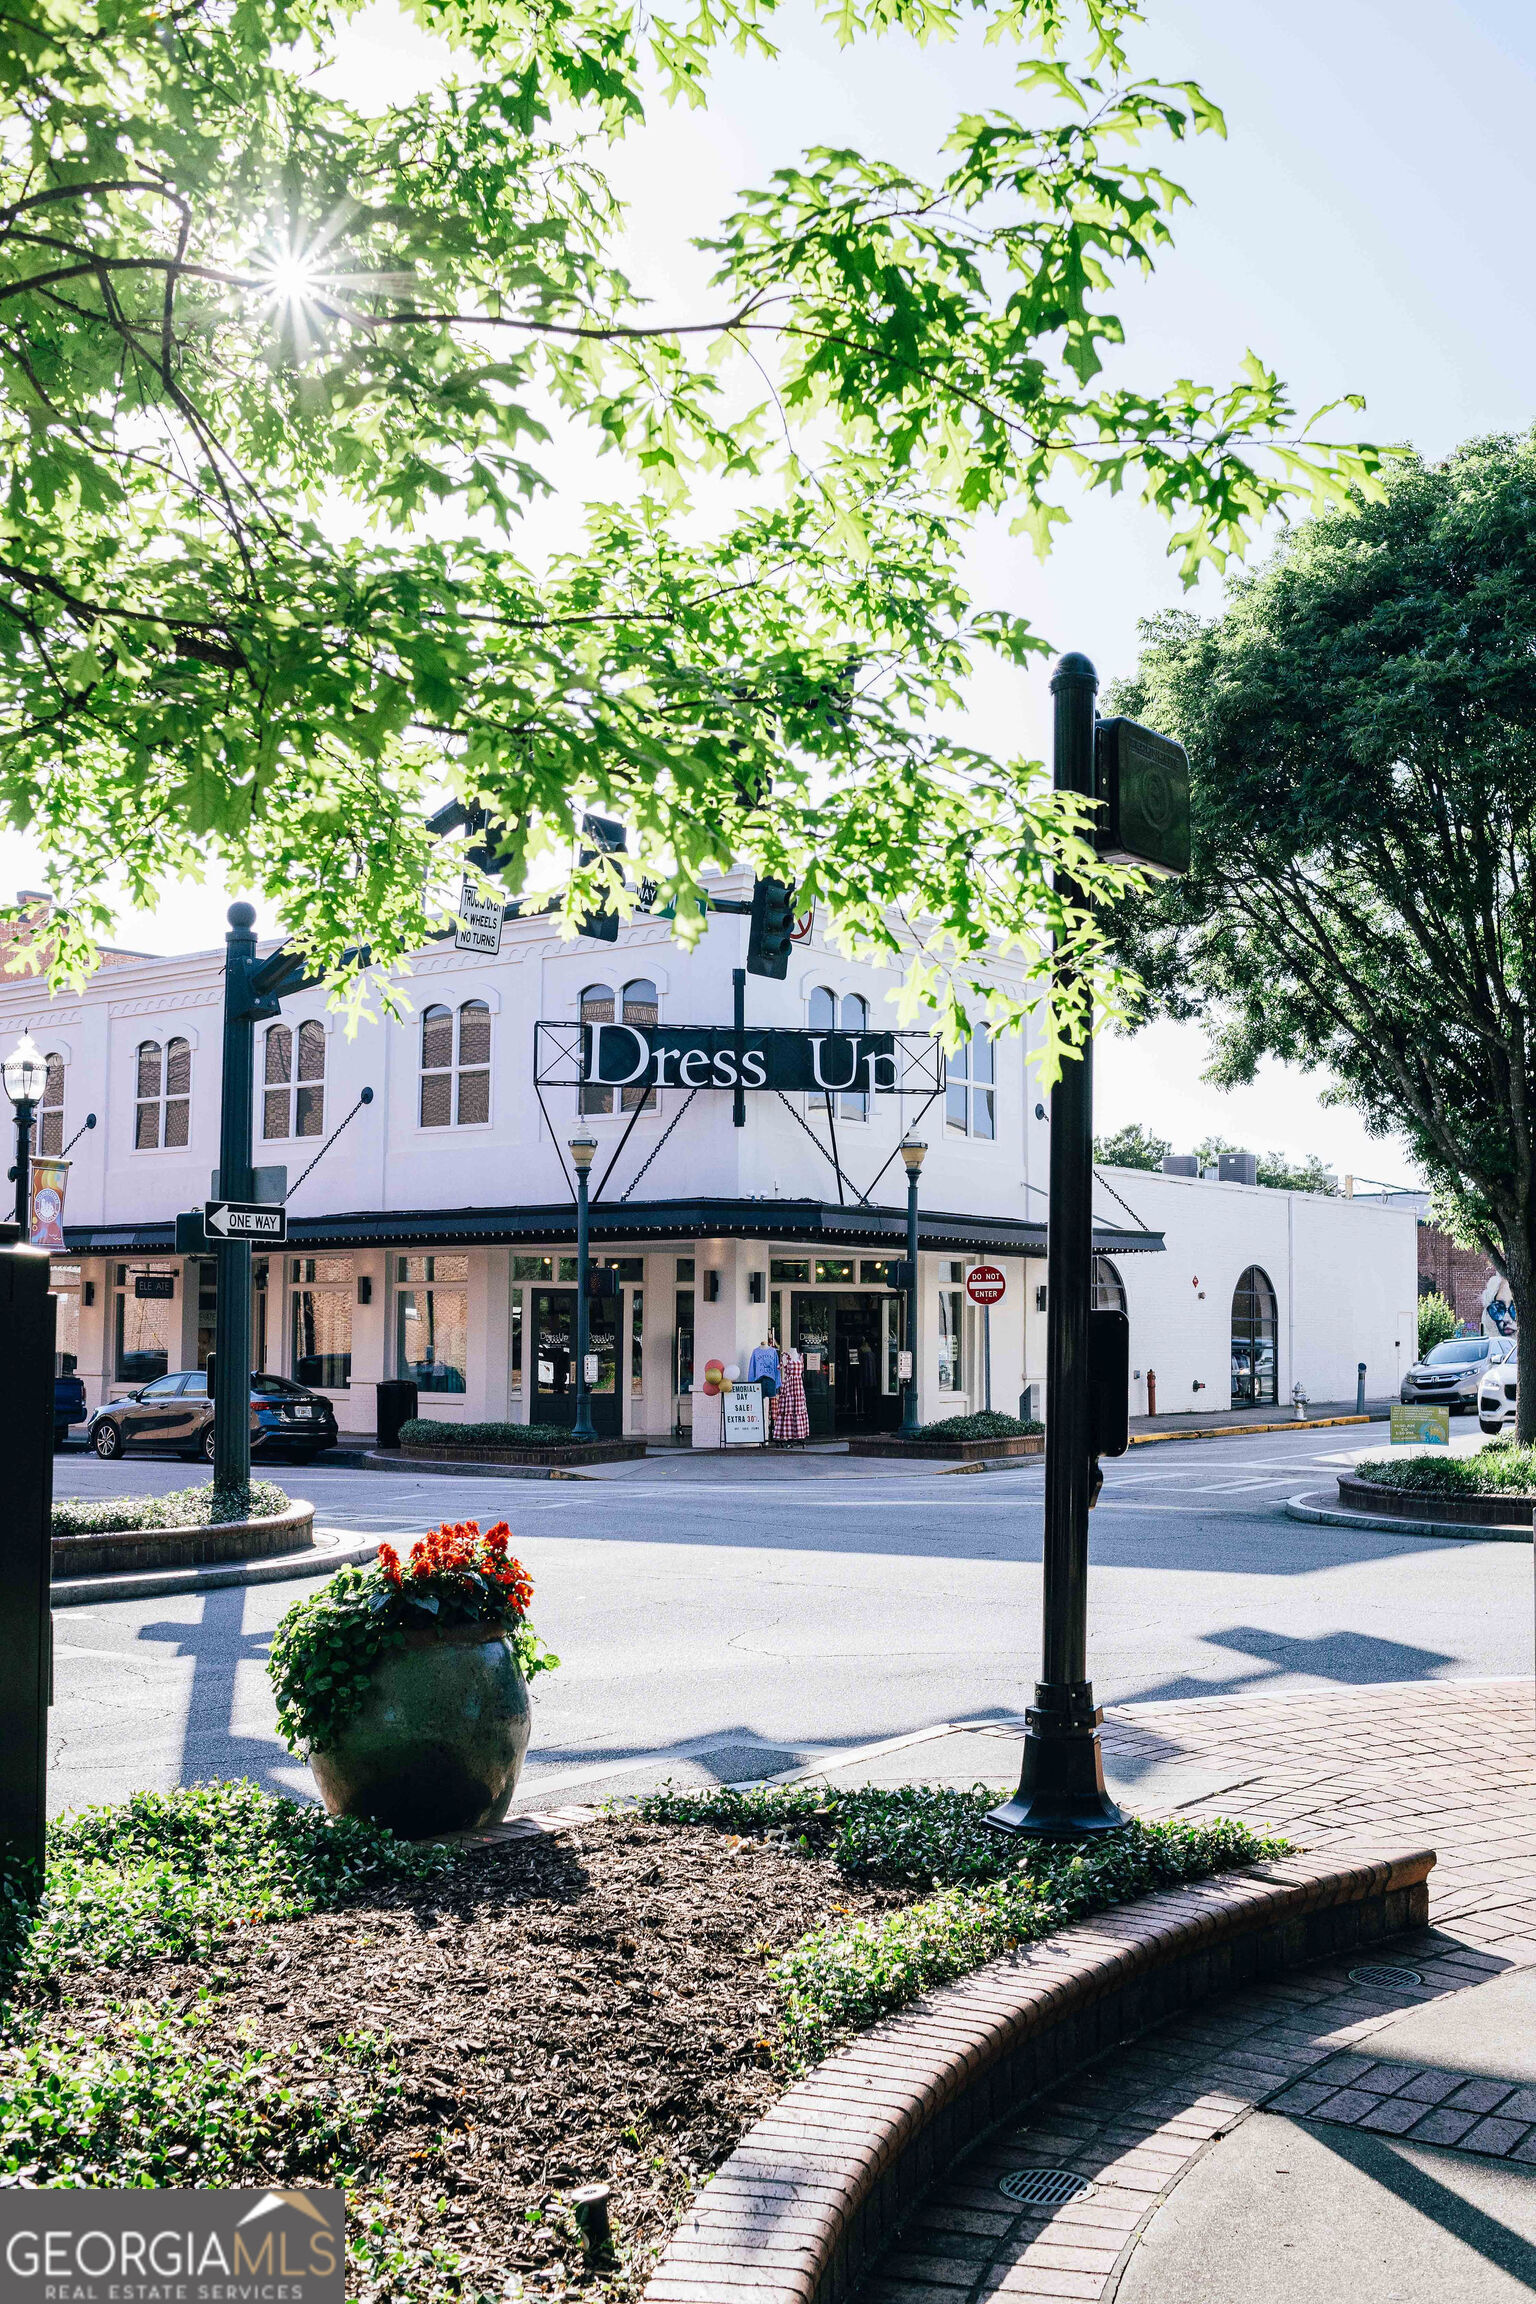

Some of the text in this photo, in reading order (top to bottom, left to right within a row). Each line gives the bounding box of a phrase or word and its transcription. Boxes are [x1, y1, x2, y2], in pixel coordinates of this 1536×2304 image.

[637, 886, 656, 901] WAY
[470, 913, 498, 930] WHEELS
[460, 930, 496, 948] NO TURNS
[584, 1021, 902, 1116] Dress Up
[229, 1213, 277, 1230] ONE WAY
[985, 1272, 1000, 1280] NOT
[139, 1280, 170, 1292] ELEATE
[732, 1385, 757, 1393] EMORIAL
[736, 1393, 748, 1401] DAY
[734, 1404, 753, 1412] SALE!
[727, 1415, 746, 1424] EXTRA
